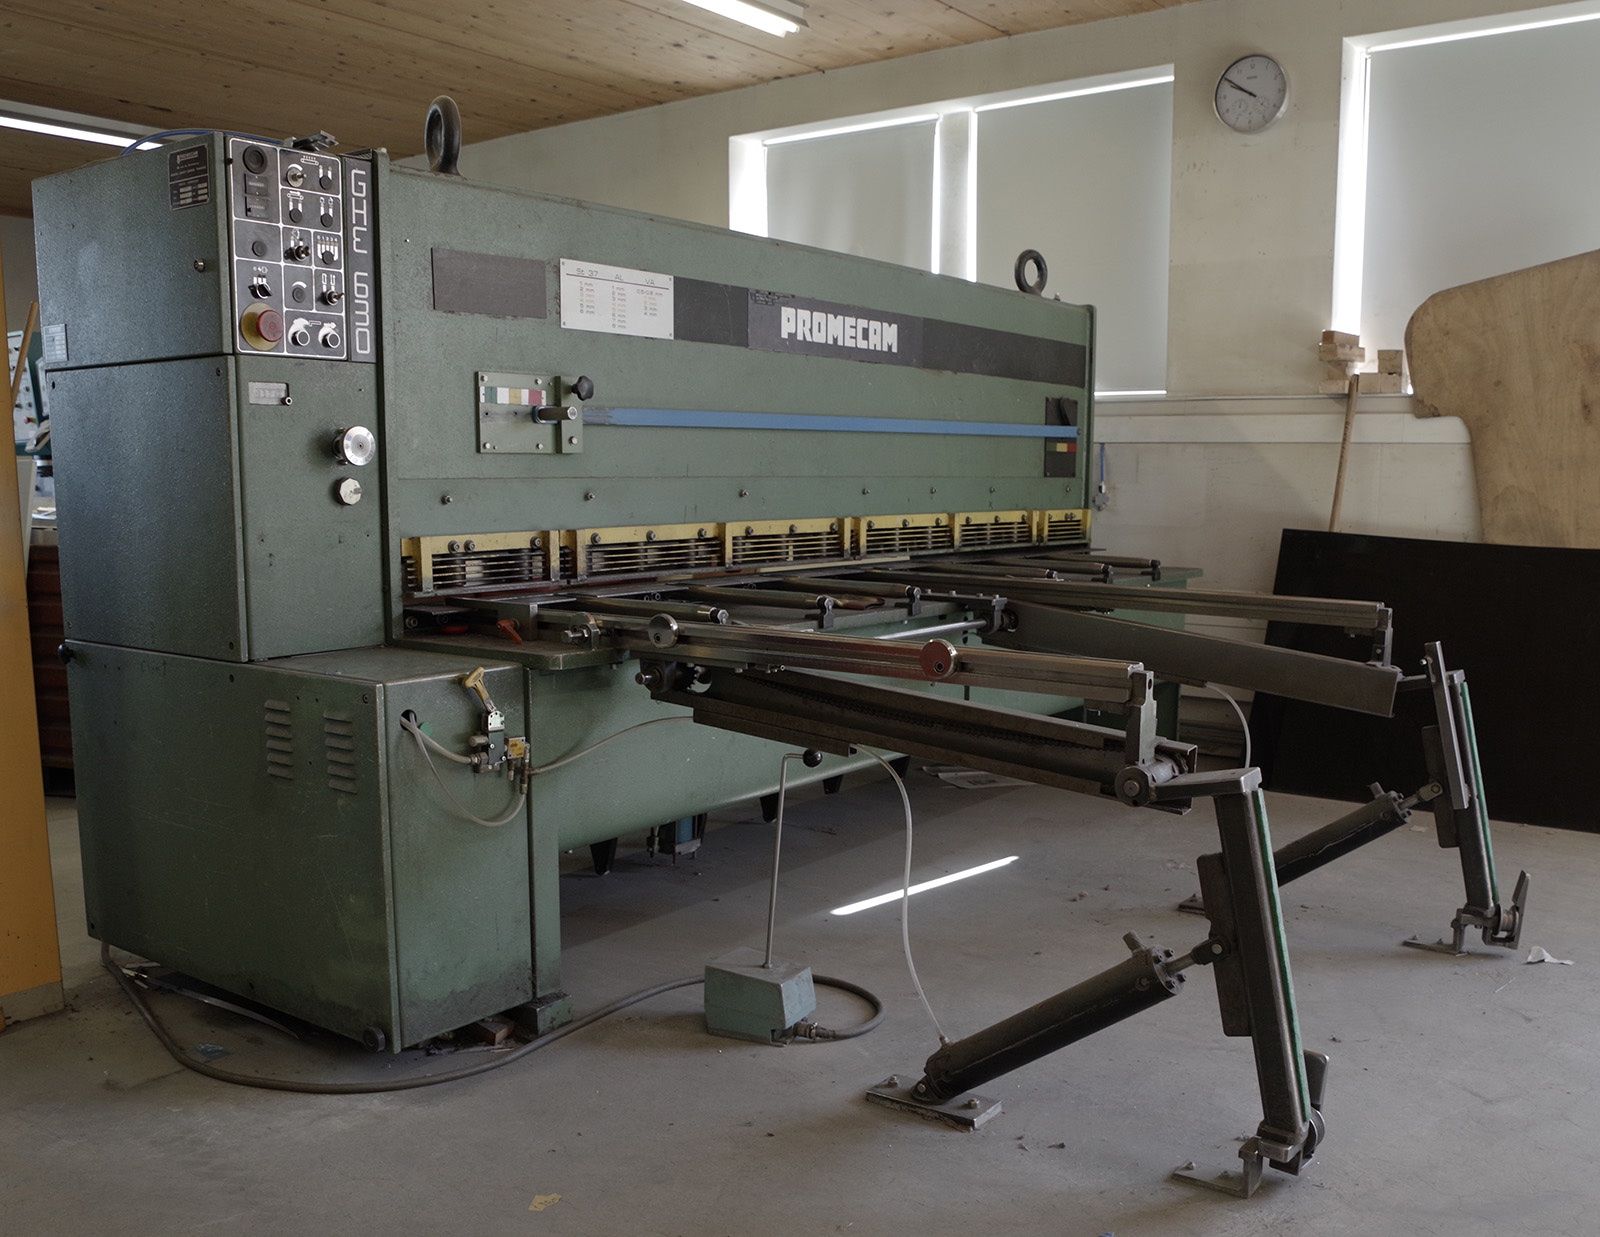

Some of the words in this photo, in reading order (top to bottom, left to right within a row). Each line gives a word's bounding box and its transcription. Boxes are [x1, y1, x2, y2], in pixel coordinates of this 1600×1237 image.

[352, 168, 368, 254] GHE
[354, 272, 370, 354] 630
[780, 306, 898, 353] PROMECAM
